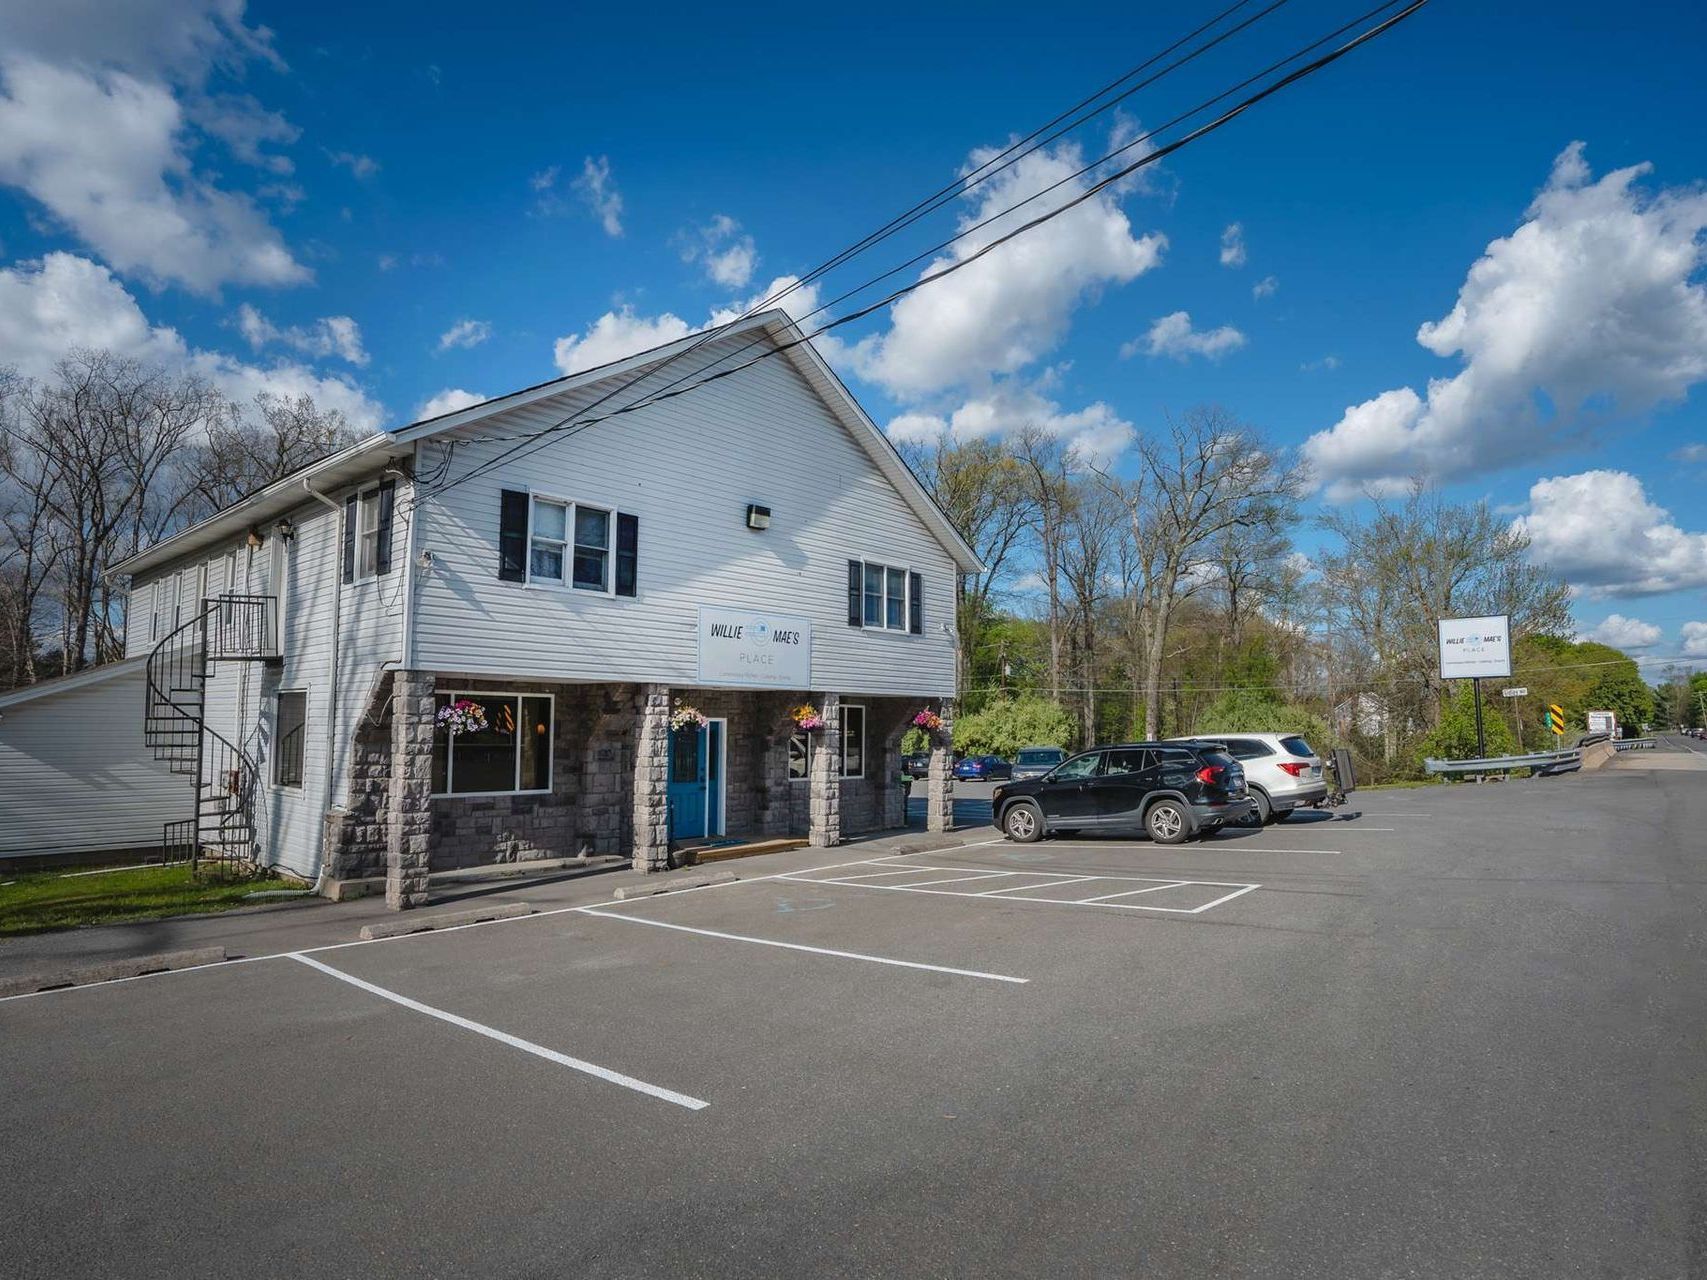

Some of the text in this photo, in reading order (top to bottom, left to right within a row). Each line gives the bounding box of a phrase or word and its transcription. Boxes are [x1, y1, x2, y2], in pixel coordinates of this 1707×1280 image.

[711, 623, 800, 645] WILLIE MAE'S
[740, 653, 774, 664] PLACE
